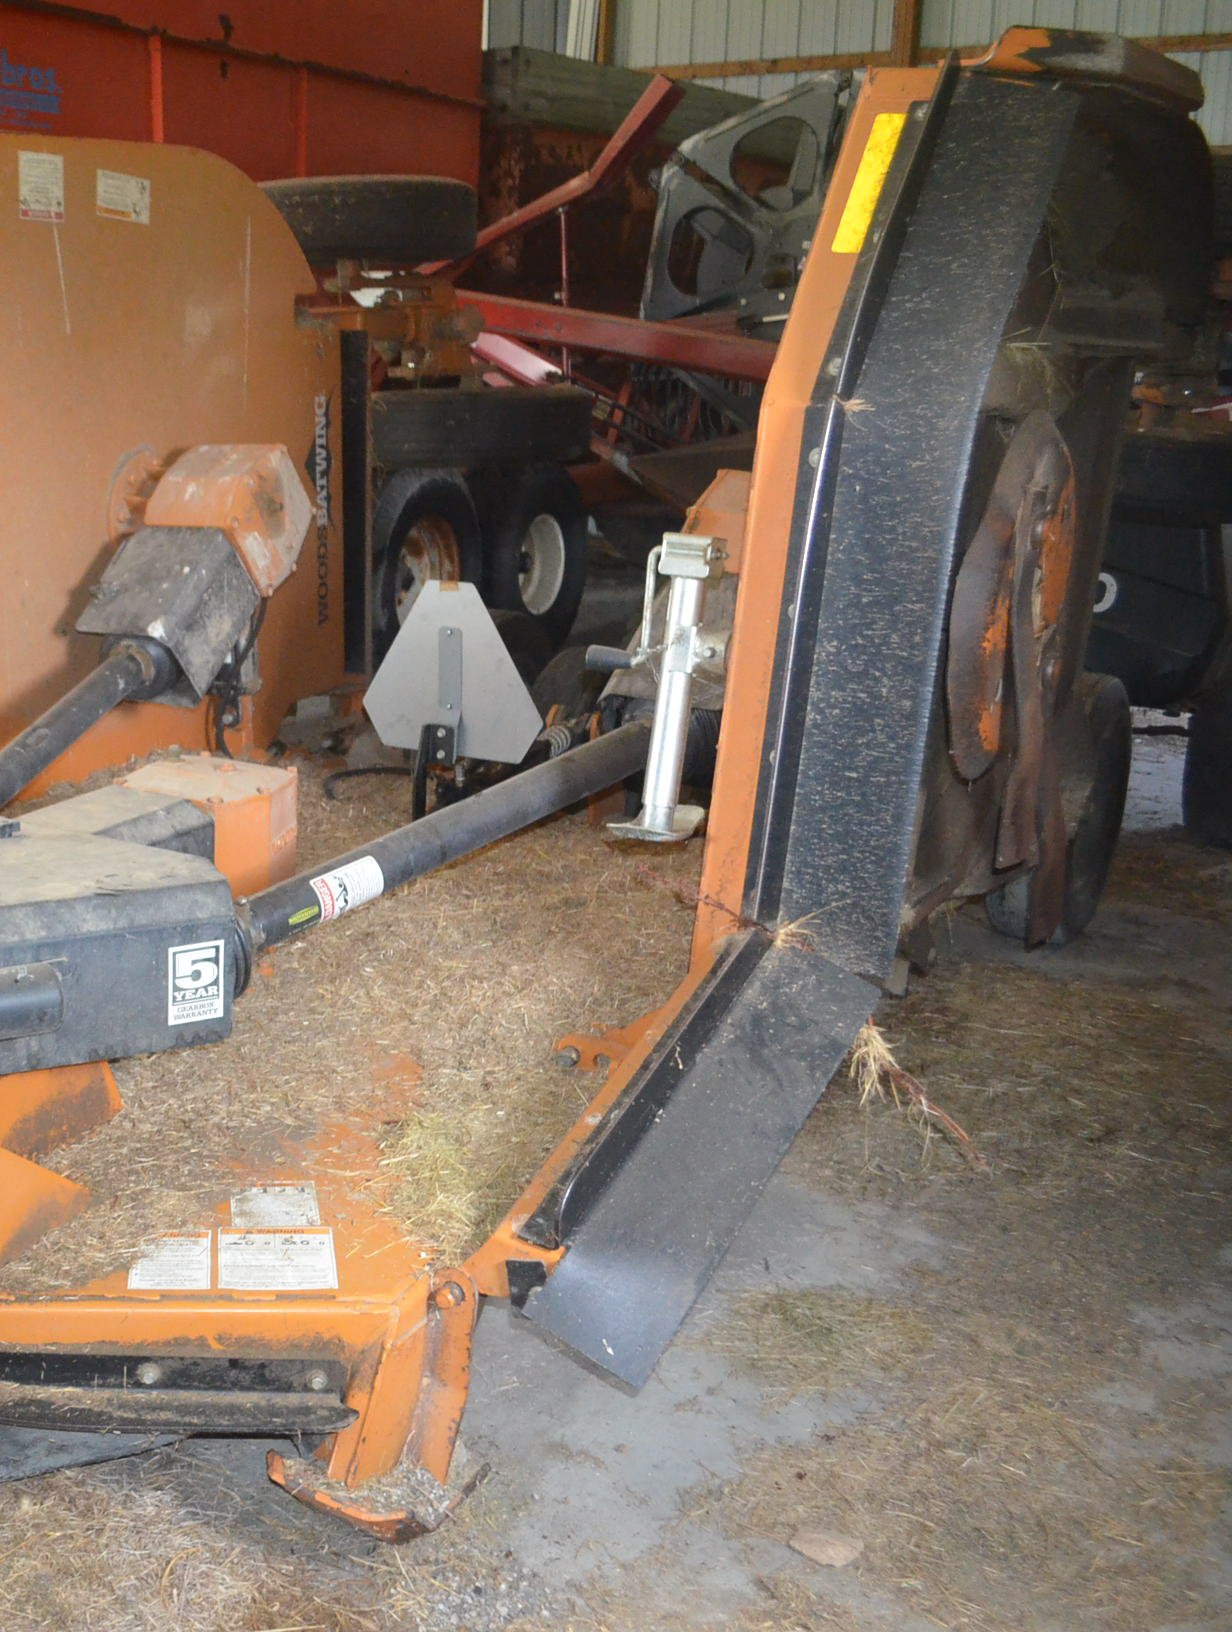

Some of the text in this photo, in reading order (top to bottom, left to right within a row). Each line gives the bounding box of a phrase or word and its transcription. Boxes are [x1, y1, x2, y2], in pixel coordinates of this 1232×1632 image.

[314, 393, 329, 526] BATWING
[174, 947, 218, 990] 5
[173, 985, 219, 1002] YEAR
